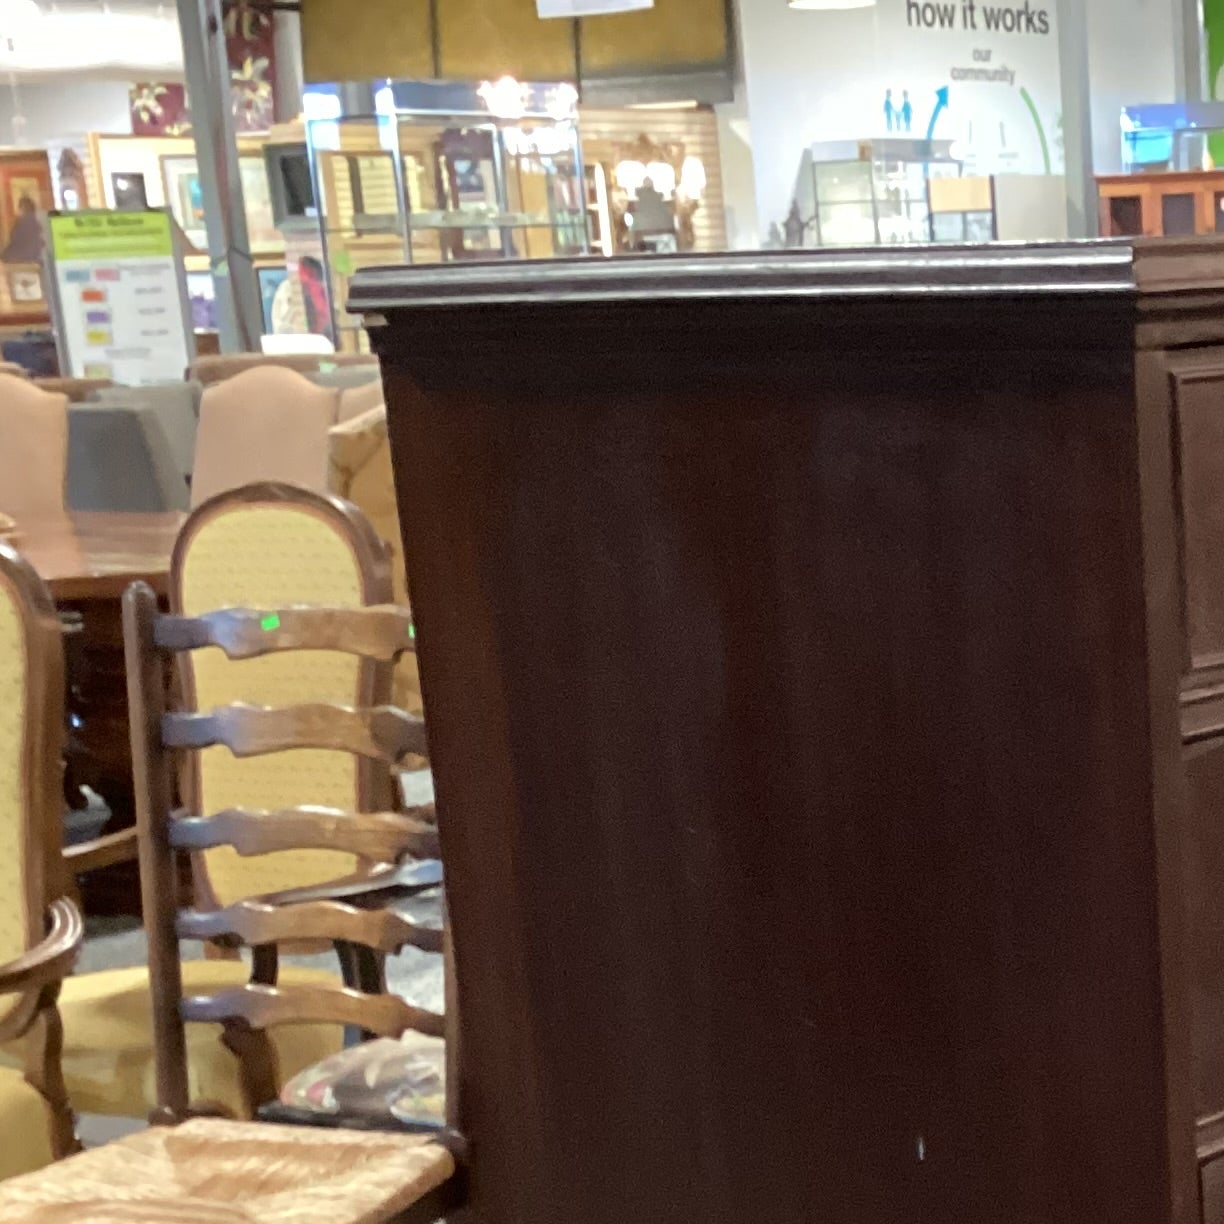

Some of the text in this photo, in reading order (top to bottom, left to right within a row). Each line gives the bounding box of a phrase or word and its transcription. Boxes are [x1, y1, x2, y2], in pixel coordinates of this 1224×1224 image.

[906, 0, 1050, 35] how it works
[972, 48, 992, 62] our
[951, 65, 1016, 86] community
